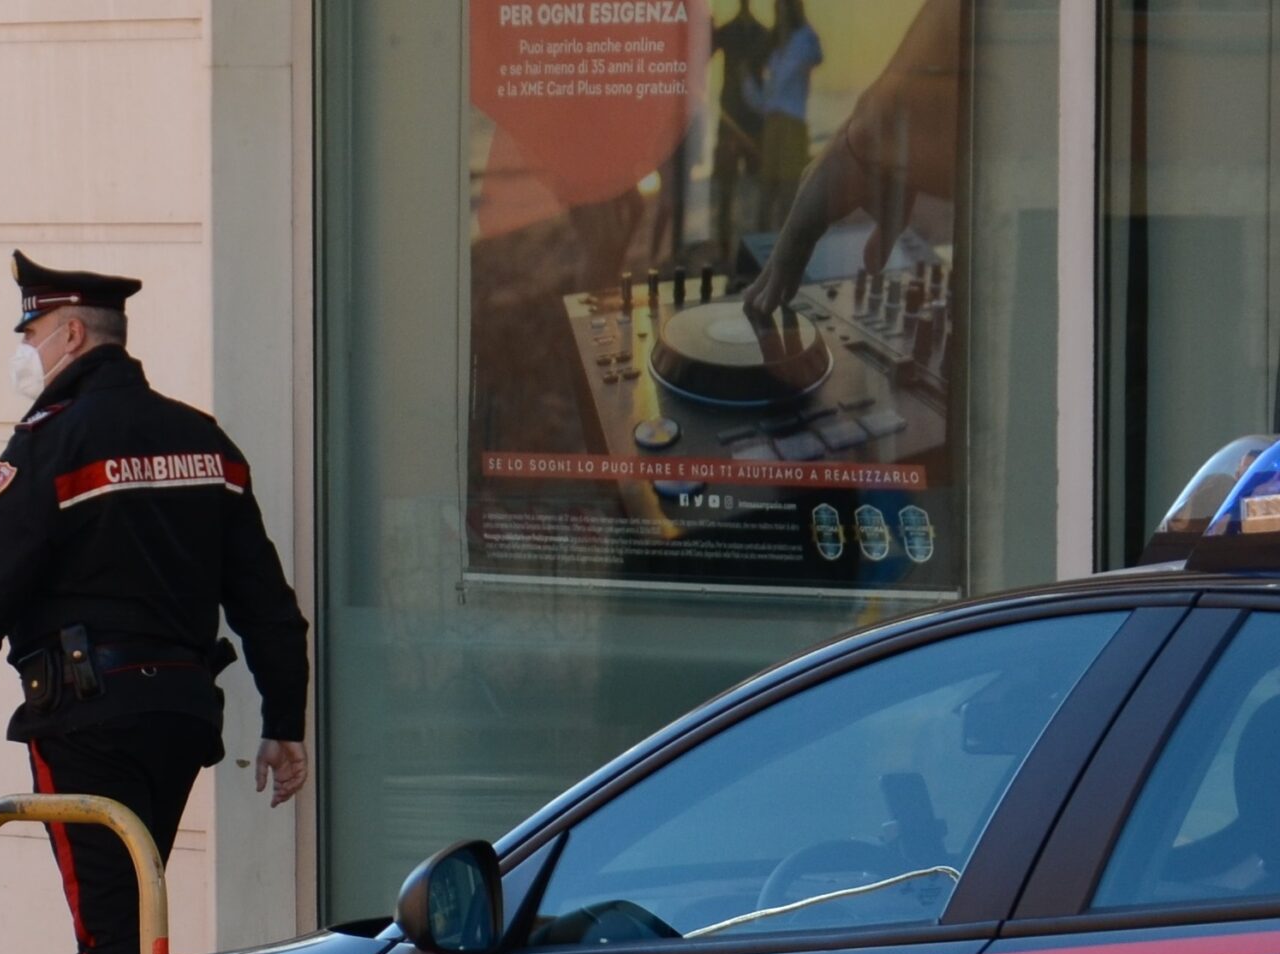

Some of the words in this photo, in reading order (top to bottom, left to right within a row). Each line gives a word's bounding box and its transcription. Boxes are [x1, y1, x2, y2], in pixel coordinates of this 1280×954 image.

[500, 5, 532, 25] PER
[538, 4, 585, 24] OGNI
[590, 2, 688, 24] ESIGENZA
[520, 40, 544, 54] Puoi
[546, 40, 583, 56] aprirlo
[586, 38, 621, 53] anche
[624, 37, 665, 52] online
[500, 64, 506, 75] e
[509, 64, 522, 75] se
[525, 61, 541, 74] hai
[545, 63, 575, 74] meno
[578, 60, 588, 74] di
[592, 60, 605, 73] 35
[608, 60, 633, 73] anni
[637, 60, 644, 72] il
[648, 61, 686, 73] conto
[498, 85, 504, 96] e
[507, 82, 517, 96] la
[520, 82, 544, 95] XME
[547, 81, 574, 95] Card
[578, 81, 601, 95] Plus
[605, 83, 632, 94] sono
[636, 80, 688, 99] gratuiti.
[104, 453, 224, 483] CARABINIERI
[489, 460, 502, 470] SE
[508, 460, 523, 470] LO
[530, 460, 571, 472] SOGNI
[578, 462, 594, 473] LO
[602, 463, 634, 473] PUOI
[640, 463, 671, 474] FARE
[679, 464, 684, 474] E
[691, 465, 714, 476] NOI
[721, 466, 731, 476] TI
[738, 467, 803, 479] AIUTIAMO
[811, 469, 818, 479] A
[825, 470, 919, 483] REALIZZARLO
